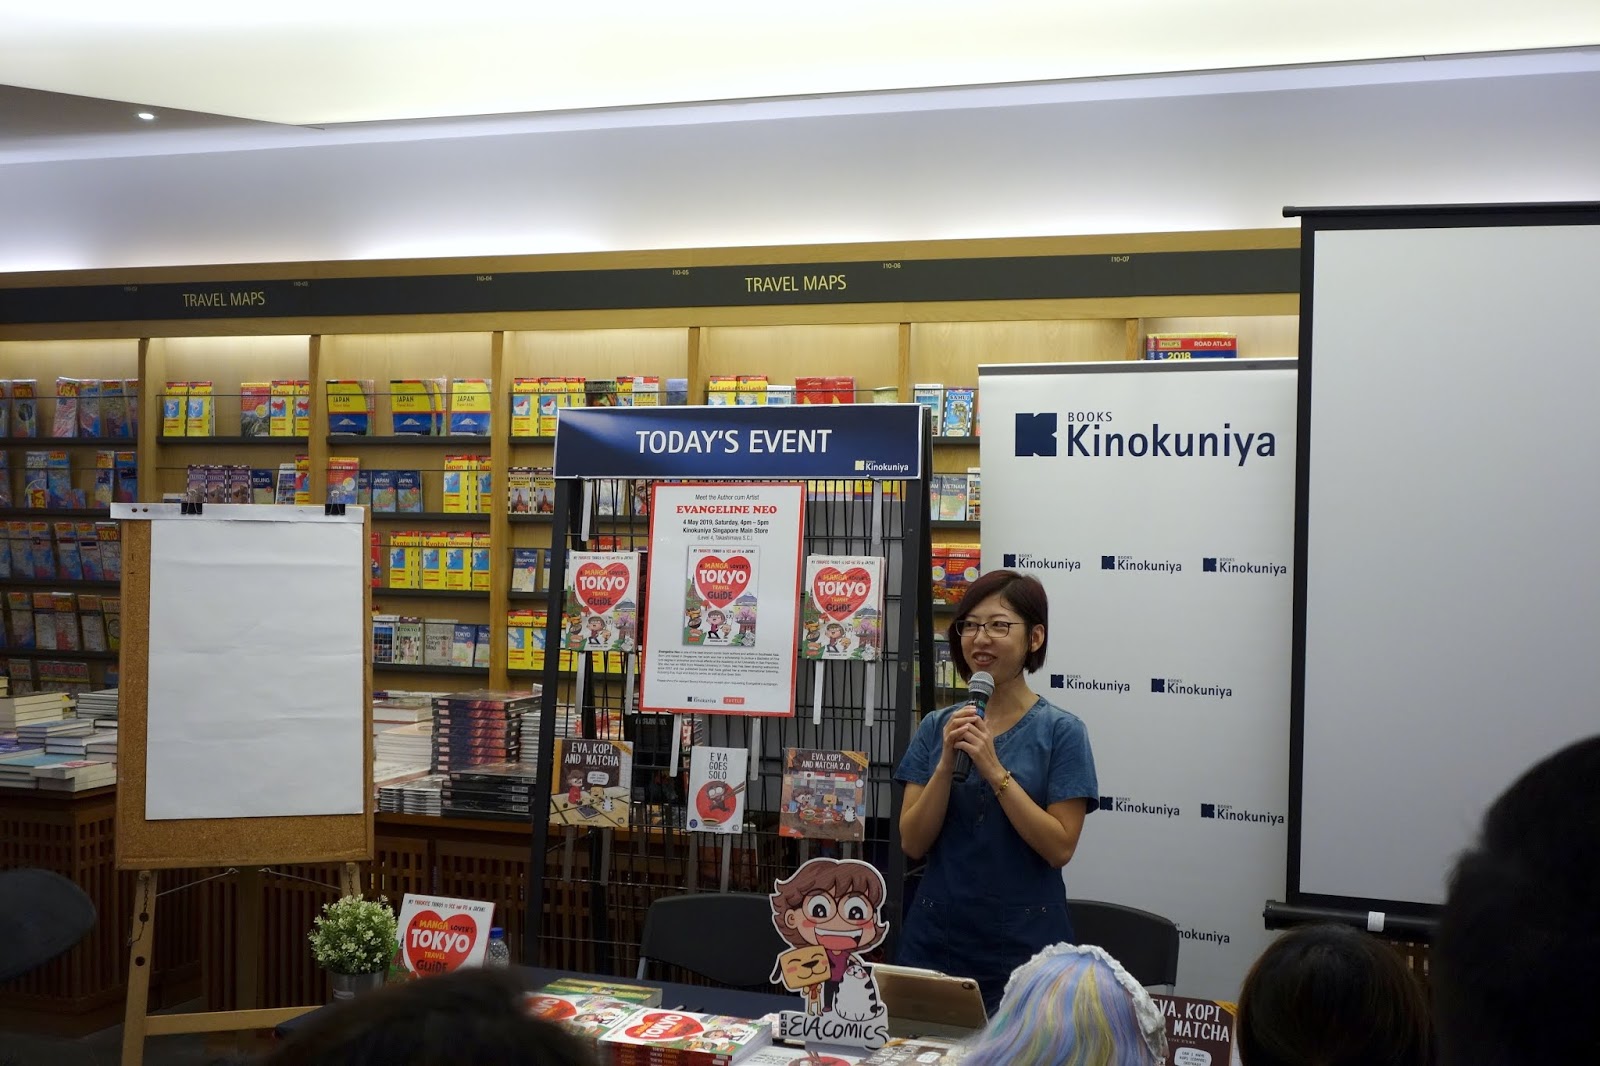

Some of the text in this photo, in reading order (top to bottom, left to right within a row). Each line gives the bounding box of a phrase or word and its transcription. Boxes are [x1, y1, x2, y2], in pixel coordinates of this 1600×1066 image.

[745, 274, 847, 292] TRAVEL MAPS
[182, 291, 266, 307] TRAVEL MAPS
[1168, 352, 1191, 360] 2018
[60, 383, 77, 396] USA
[1068, 412, 1113, 422] BOOKS
[636, 429, 832, 454] TODAY'S EVENT
[1067, 423, 1276, 466] Kinokuniya
[865, 462, 909, 471] Kinokuniya
[676, 506, 777, 514] EVANGELINE NEO
[100, 530, 118, 540] TOKYO
[1018, 558, 1081, 572] Kinokuniya
[1117, 560, 1182, 574] Kinokuniya
[1219, 562, 1287, 576] Kinokuniya
[580, 576, 626, 590] TOKYO
[700, 570, 746, 584] TOKYO
[818, 582, 867, 597] TOKYO
[1066, 679, 1130, 693] Kinokuniya
[1167, 683, 1232, 699] Kinokuniya
[593, 744, 613, 754] KOPI
[565, 753, 619, 766] AND MATCHA
[710, 752, 728, 761] EVA
[709, 762, 728, 770] GOES
[815, 761, 838, 770] MATCHA
[709, 771, 727, 780] SOLO
[1116, 801, 1180, 818] Kinokuniya
[1217, 809, 1284, 826] Kinokuniya
[419, 920, 449, 930] MANGA
[451, 925, 473, 933] LOVER'S
[411, 929, 470, 953] TOKYO
[1176, 928, 1230, 945] nokuniya
[424, 951, 445, 960] TRAVEL
[1186, 1002, 1221, 1023] KOPI
[640, 1014, 683, 1038] TOKYO
[1173, 1020, 1230, 1043] MATCHA
